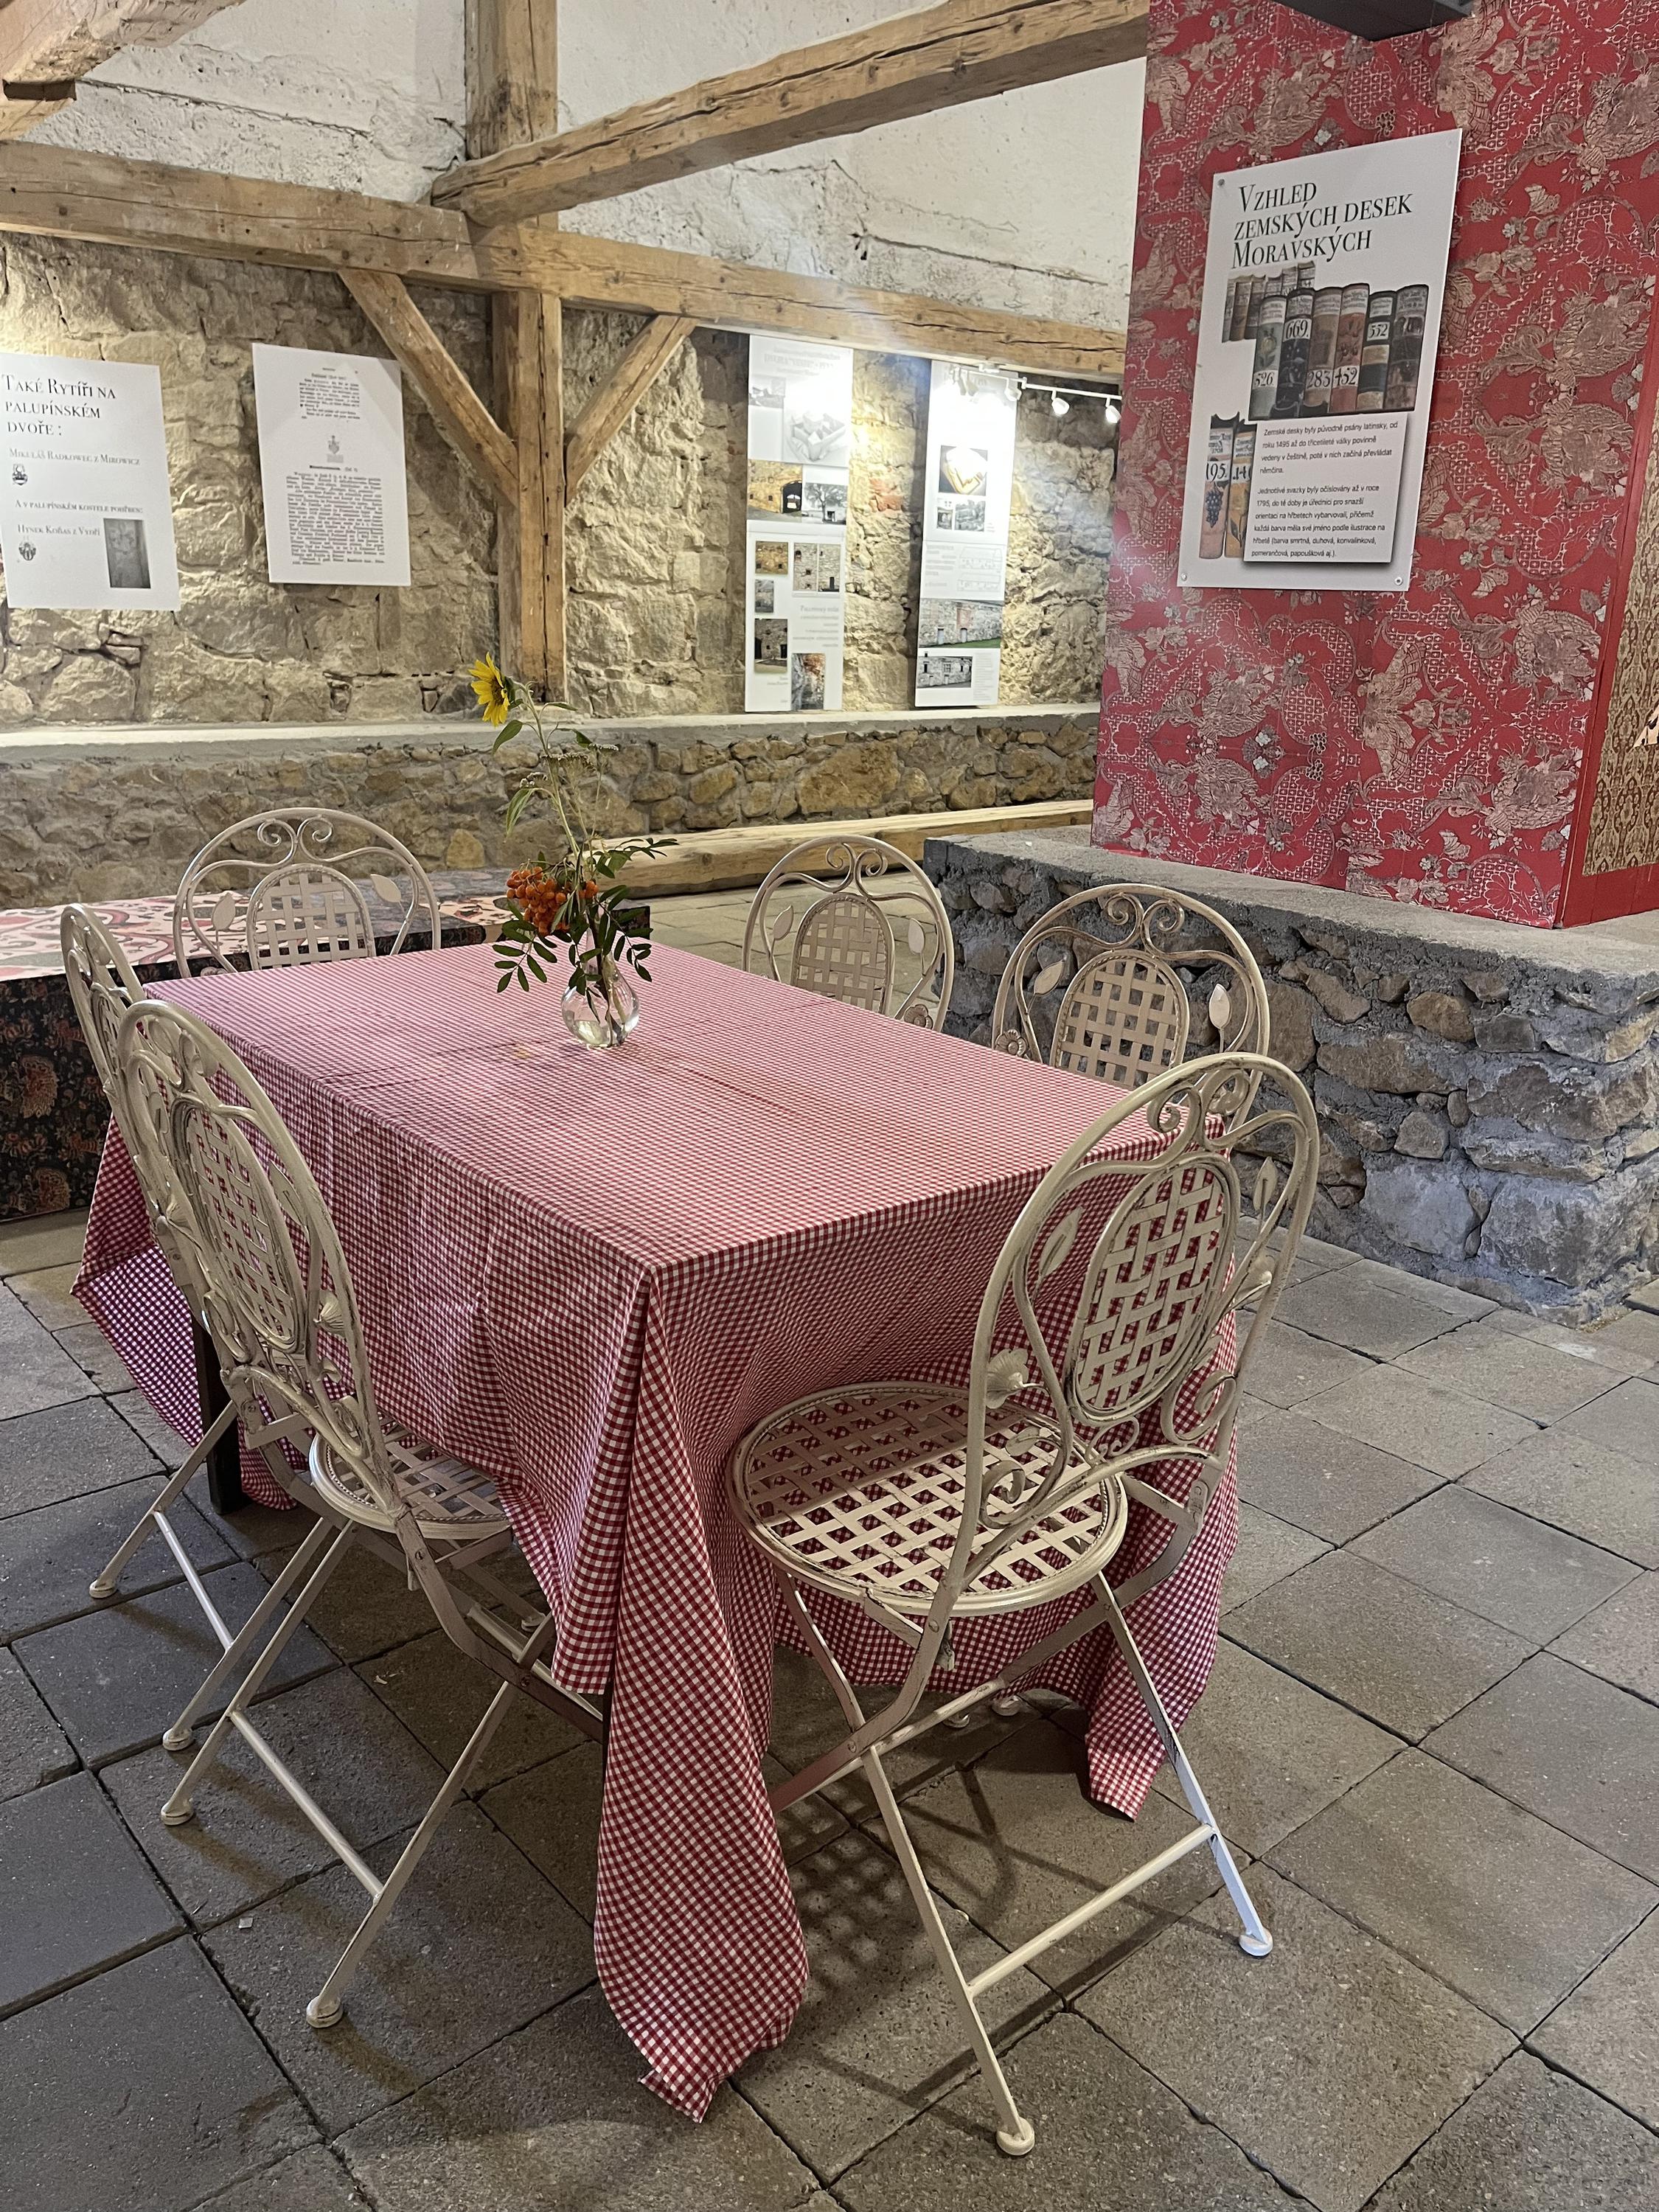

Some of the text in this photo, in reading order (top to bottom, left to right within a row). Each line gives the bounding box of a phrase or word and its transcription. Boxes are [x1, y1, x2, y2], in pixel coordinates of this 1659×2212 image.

[1239, 183, 1317, 212] VZHLED
[1344, 194, 1413, 223] DESEK
[97, 387, 116, 399] NA
[6, 400, 100, 419] PALUPÍNSKÉM
[1264, 428, 1285, 436] Zemské
[1287, 426, 1302, 434] desky
[1318, 423, 1343, 434] původně
[1352, 436, 1377, 444] povinně
[1364, 449, 1392, 458] převládat
[1287, 486, 1305, 494] svazky
[1320, 484, 1350, 493] očíslovány
[1345, 497, 1364, 505] snazší
[1349, 510, 1374, 519] přičemž
[1313, 524, 1331, 532] jméno
[1332, 524, 1349, 532] podle
[1271, 538, 1288, 546] (barva
[1312, 537, 1335, 545] duhová,
